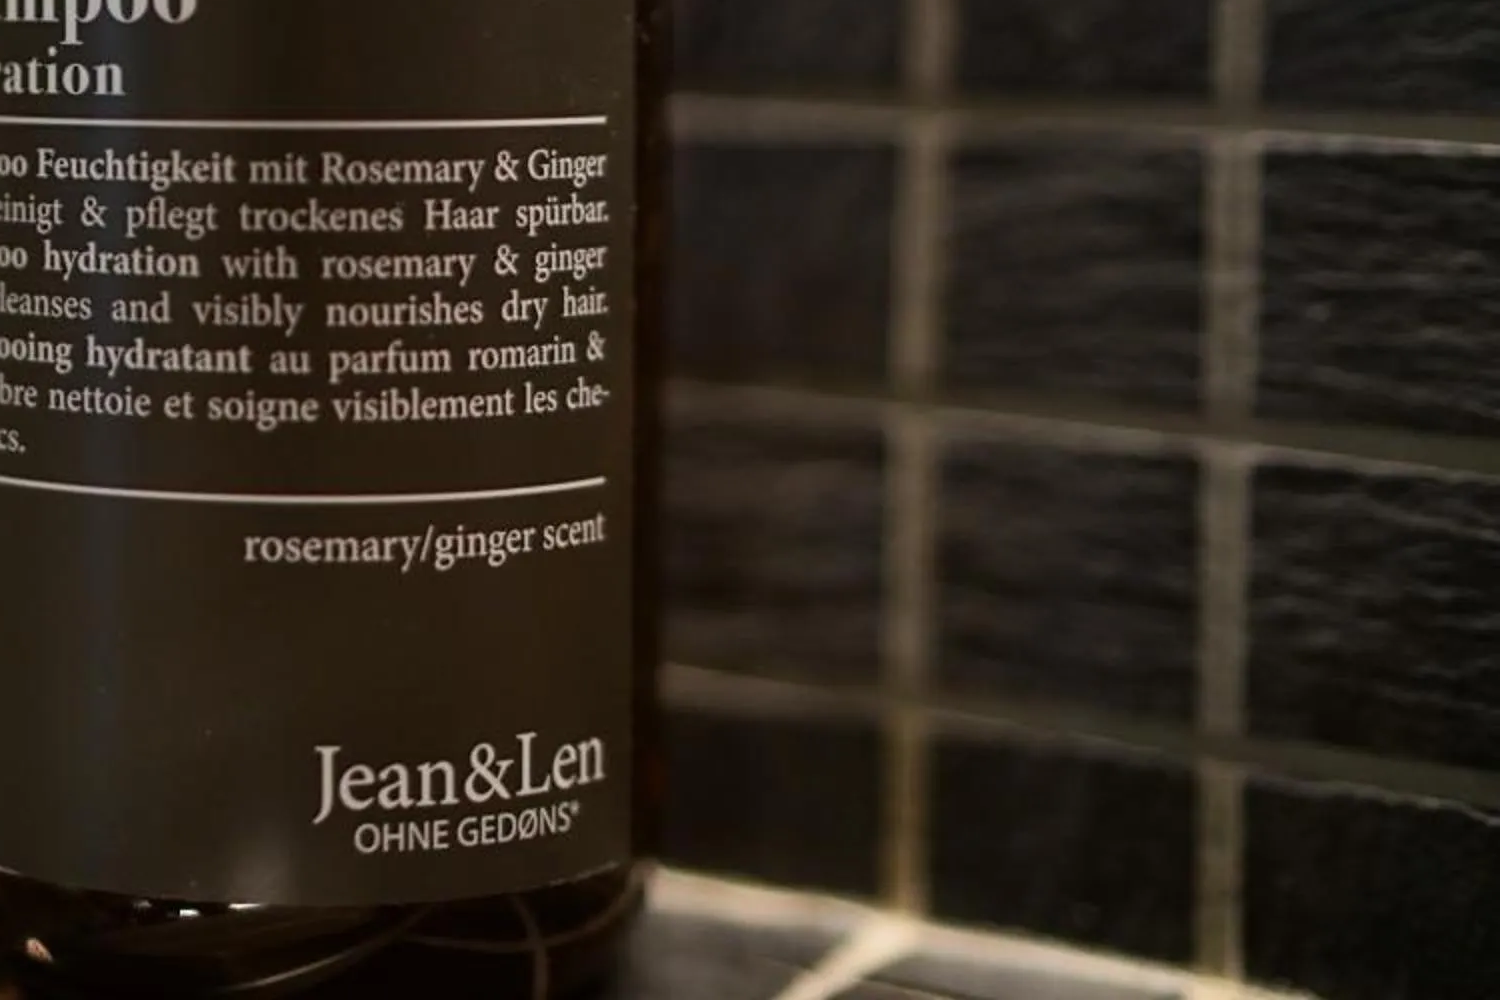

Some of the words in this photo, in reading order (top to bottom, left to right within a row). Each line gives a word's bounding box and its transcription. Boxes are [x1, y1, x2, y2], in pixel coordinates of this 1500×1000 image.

[35, 147, 235, 192] Feuchtigkeit
[250, 152, 308, 185] mit
[321, 153, 485, 193] Rosemary
[494, 150, 520, 182] &
[527, 149, 607, 188] Ginger
[80, 195, 108, 228] &
[125, 196, 218, 240] pflegt
[240, 200, 404, 233] trockenes
[424, 198, 500, 231] Haar
[515, 193, 610, 237] spürbar.
[43, 240, 200, 282] hydration
[222, 246, 299, 279] with
[322, 254, 477, 287] rosemary
[494, 244, 520, 276] &
[534, 243, 607, 283] ginger
[111, 290, 171, 324] and
[192, 295, 303, 337] visibly
[326, 291, 484, 327] nourishes
[501, 289, 548, 331] dry
[562, 286, 609, 317] hair.
[85, 333, 251, 377] hydratant
[269, 347, 310, 374] au
[329, 341, 452, 383] parfum
[467, 335, 576, 371] romarin
[586, 330, 606, 361] &
[48, 386, 151, 417] nettoie
[163, 391, 194, 419] et
[207, 392, 319, 432] soigne
[332, 386, 515, 421] visiblement
[523, 381, 558, 413] les
[565, 376, 610, 409] che-
[243, 525, 535, 572] rosemary/ginger
[542, 512, 607, 548] scent
[312, 731, 607, 825] Jean&Len
[353, 818, 450, 854] OHNE
